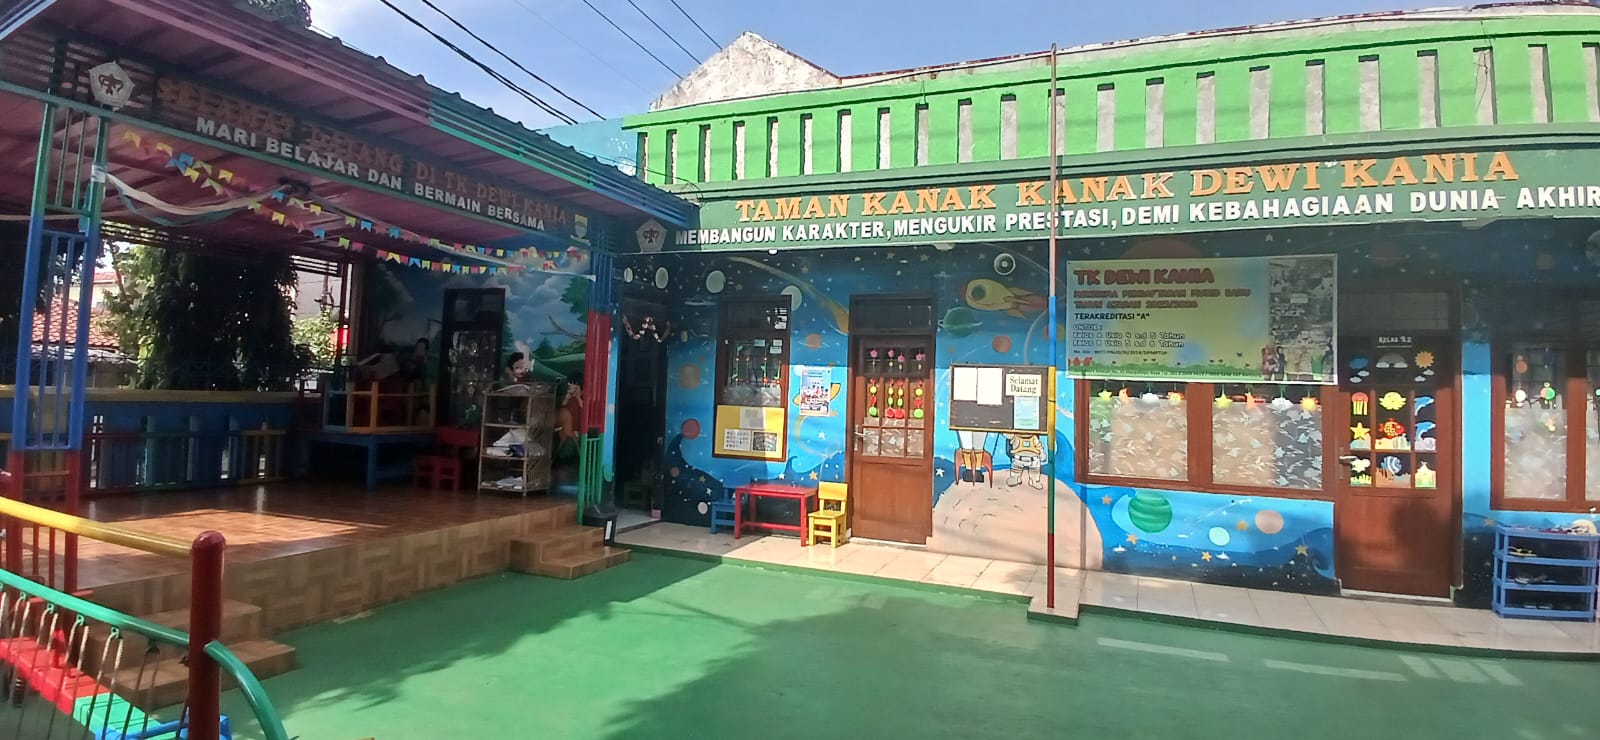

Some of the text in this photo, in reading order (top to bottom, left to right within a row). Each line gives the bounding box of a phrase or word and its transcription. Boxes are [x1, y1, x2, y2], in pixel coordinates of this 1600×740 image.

[196, 116, 546, 232] MARI BELAJAR DAN BERMAIN BERSAMA
[415, 160, 436, 184] DI
[444, 171, 469, 194] TK
[476, 181, 517, 206] DEWI
[523, 197, 568, 225] KANIA
[735, 151, 1520, 223] TAMAN KANAK KANAK DEWI KANIA
[675, 225, 776, 246] MEMBANGUN
[1121, 204, 1180, 226] DEMI
[1189, 192, 1394, 223] KEBAHAGIAAN
[1409, 188, 1500, 213] DUNIA
[1073, 267, 1216, 286] TK DEWI KANIA
[1074, 312, 1150, 320] TERAKREDITASI "A"
[1073, 331, 1094, 339] Kelas
[1105, 331, 1122, 339] Usia
[1160, 332, 1185, 340] Tahun
[1073, 339, 1094, 347] Kelas
[1105, 339, 1122, 347] Usia
[1159, 339, 1185, 348] Tahun
[1009, 375, 1039, 385] Selamat
[1010, 384, 1037, 395] Datang
